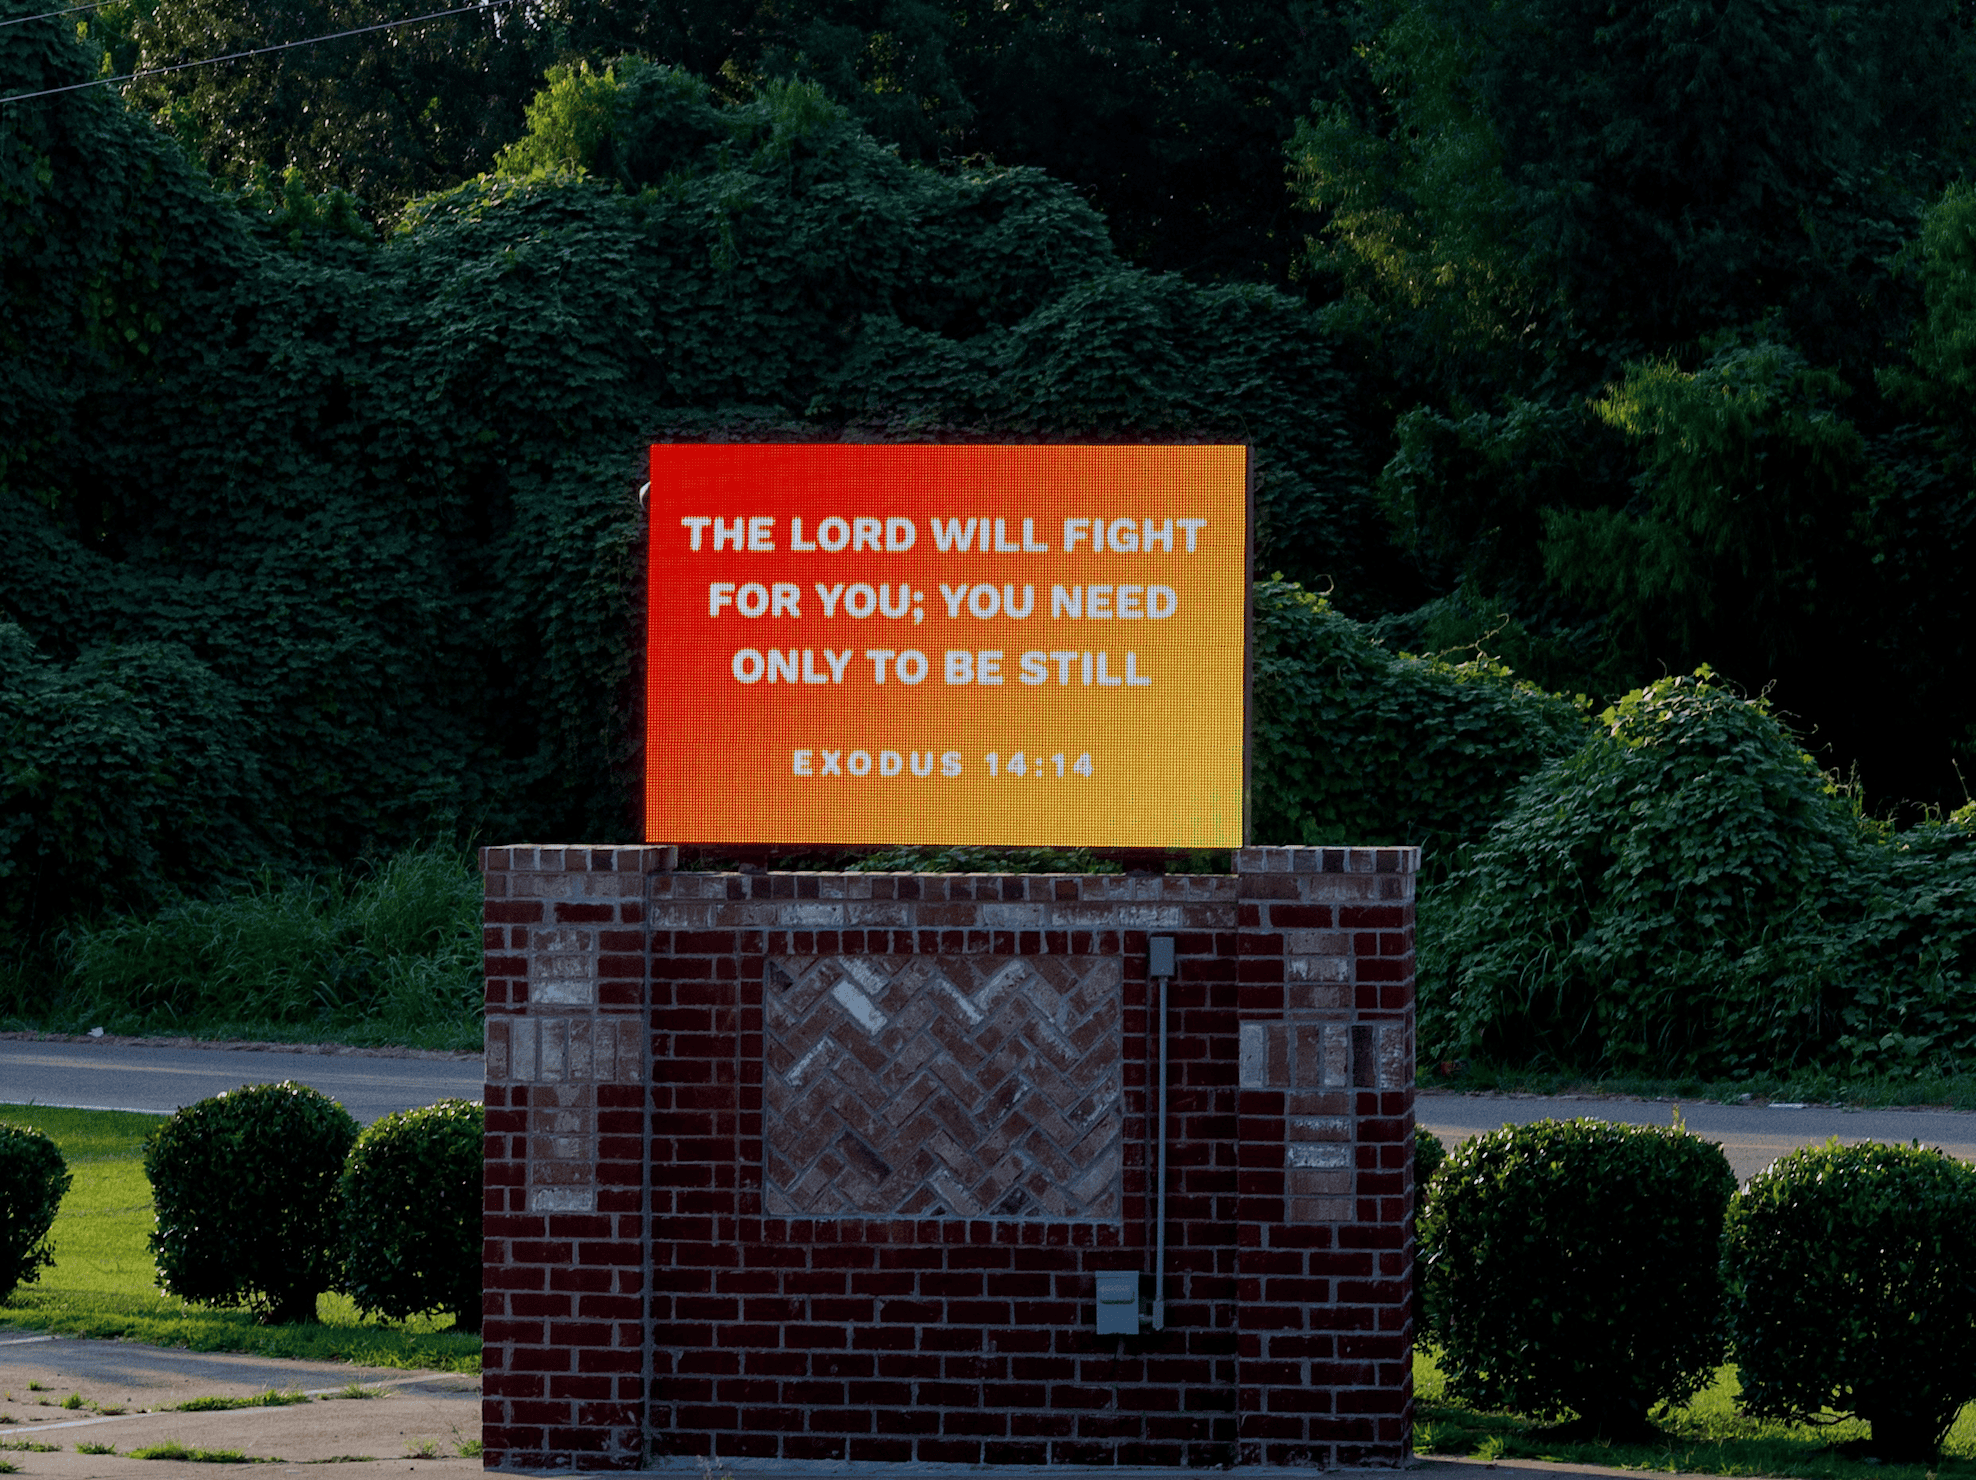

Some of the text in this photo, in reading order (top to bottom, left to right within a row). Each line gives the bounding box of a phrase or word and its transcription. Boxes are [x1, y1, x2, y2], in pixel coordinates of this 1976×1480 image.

[682, 517, 1206, 553] THE LORD WILL FIGHT
[709, 582, 1178, 624] FOR YOU; YOU NEED
[732, 649, 1151, 686] ONLY TO BE STILL
[792, 749, 1094, 778] EXODUS 14:14
